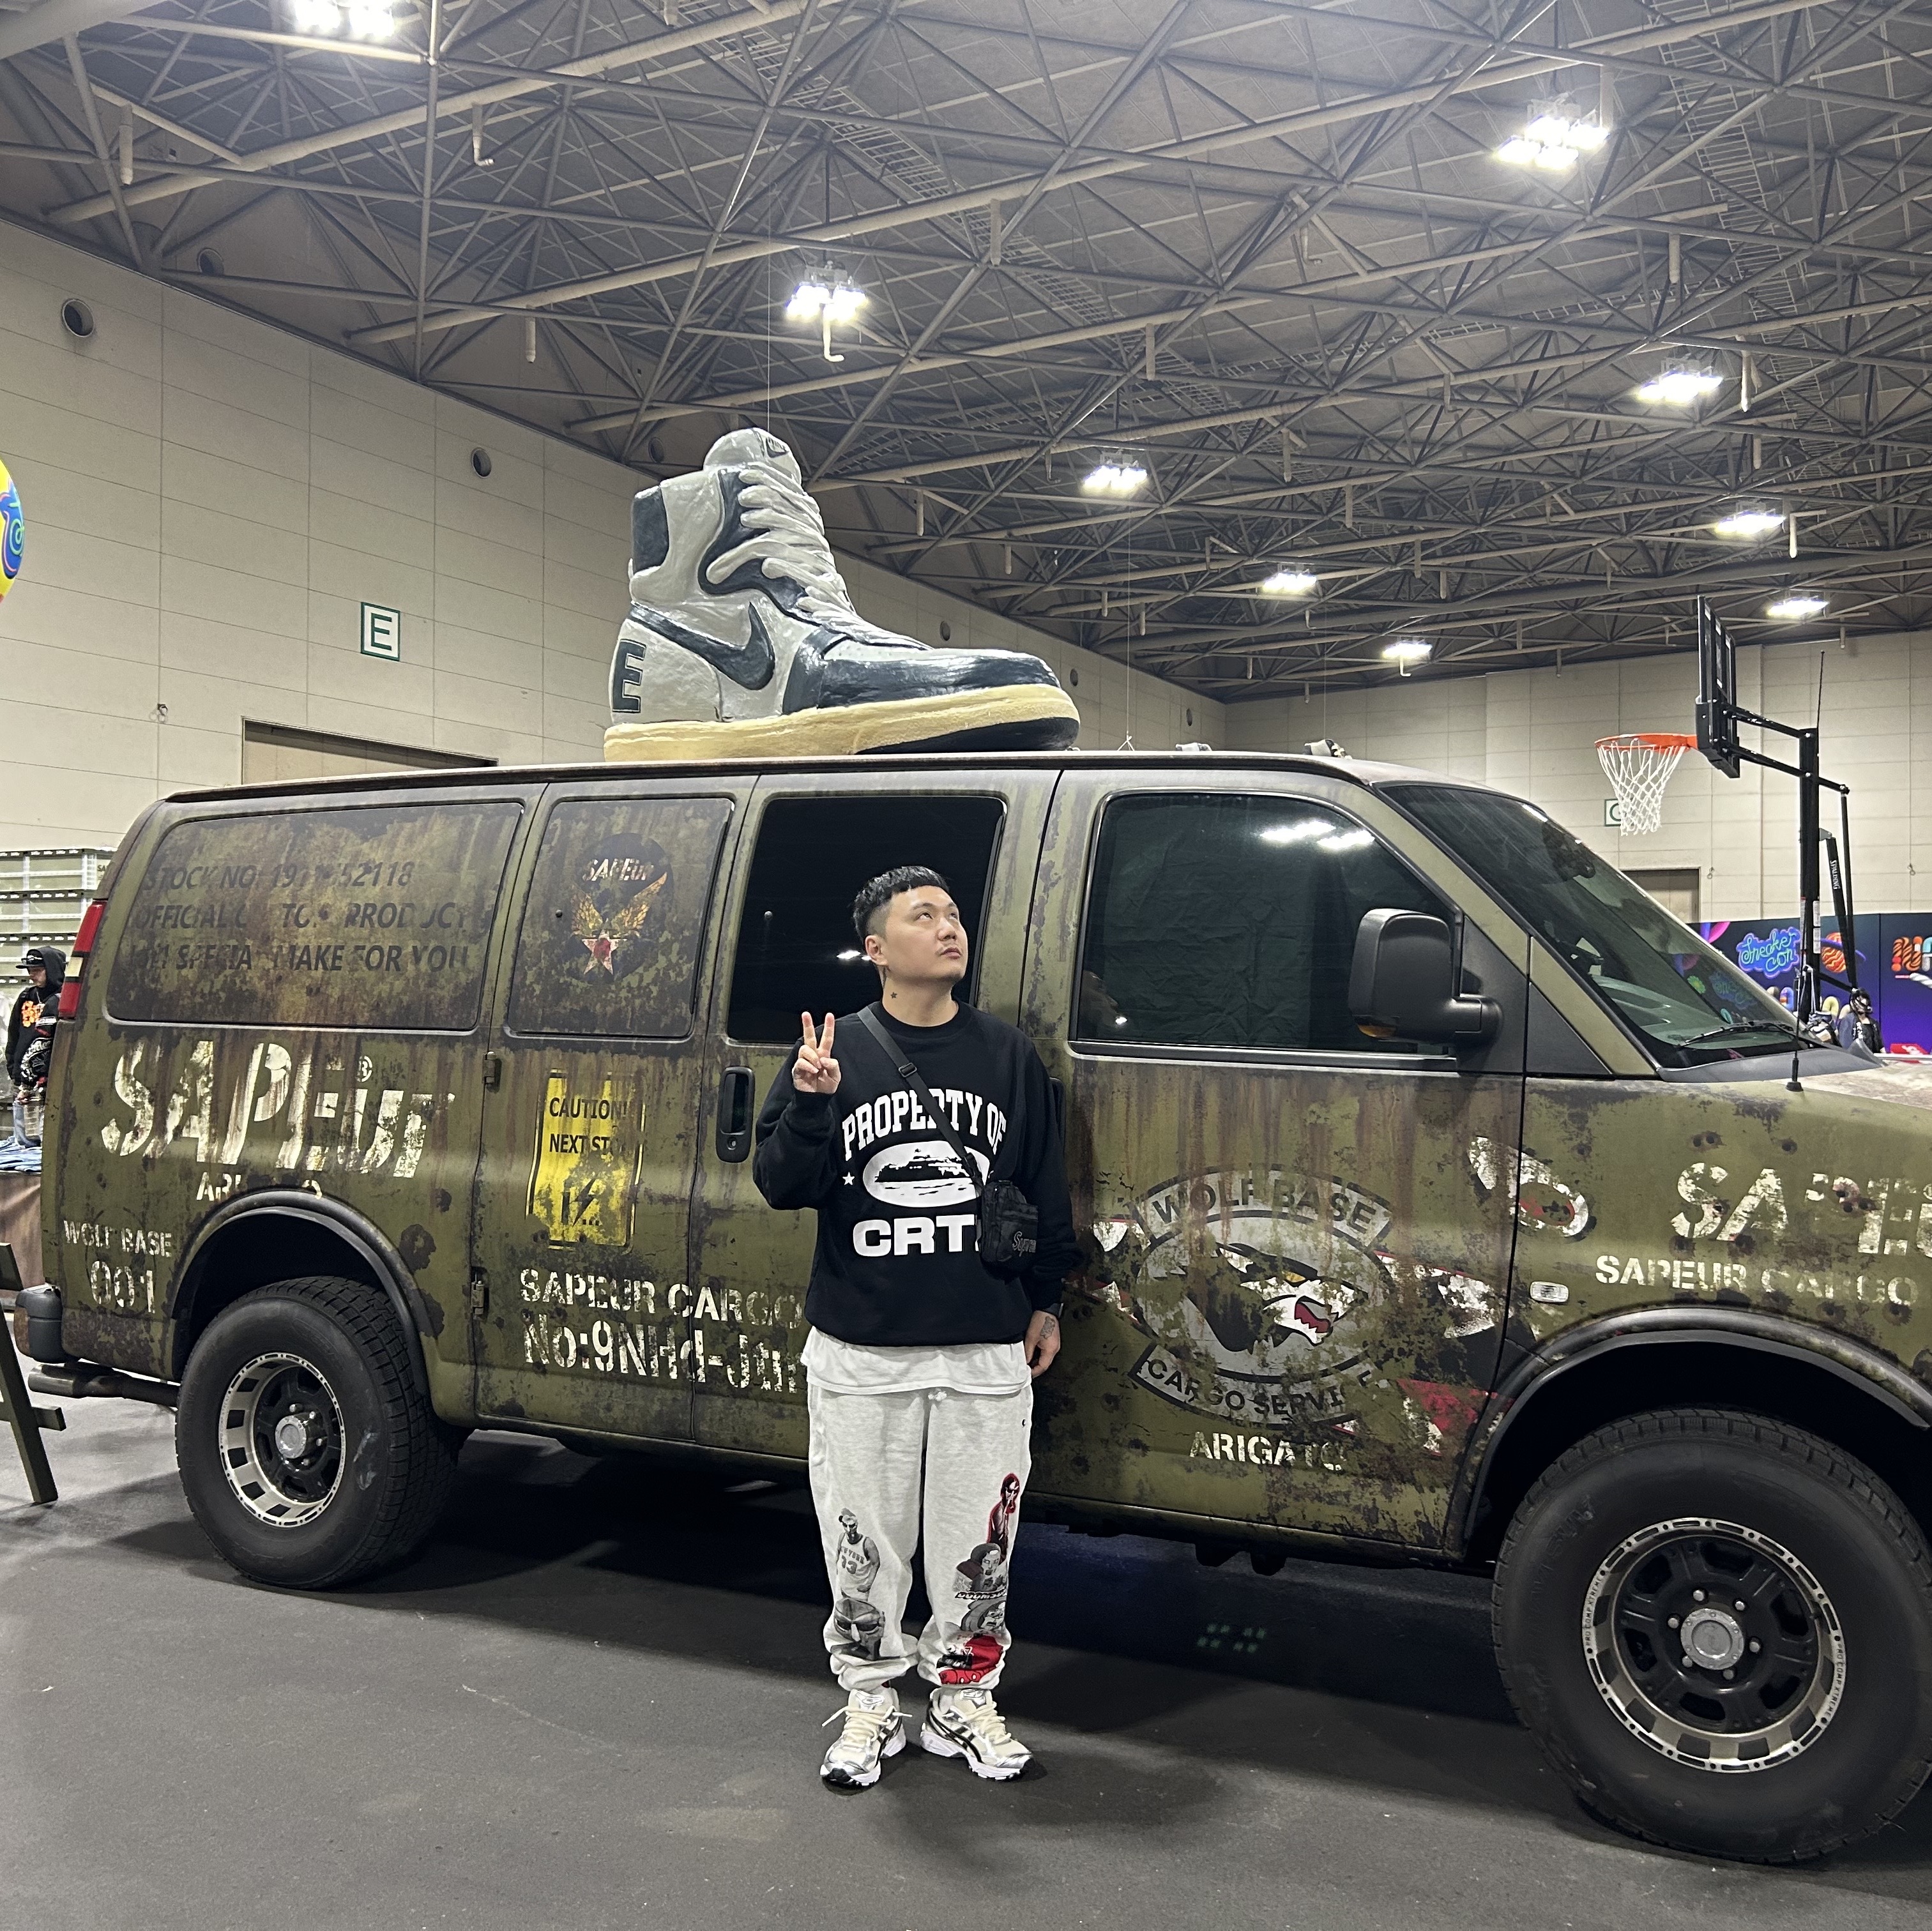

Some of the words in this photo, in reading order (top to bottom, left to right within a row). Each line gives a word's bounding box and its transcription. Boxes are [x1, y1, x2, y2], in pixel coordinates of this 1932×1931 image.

[371, 612, 392, 651] E
[612, 639, 646, 713] E
[549, 1133, 589, 1155] NEXT
[1271, 1178, 1377, 1235] BASE
[121, 1227, 172, 1258] BASE
[853, 1214, 981, 1257] CRT
[90, 1260, 156, 1314] 001
[1596, 1254, 1747, 1292] SAPEUR
[519, 1268, 656, 1315] SAPEUR
[667, 1283, 803, 1329] CARGO
